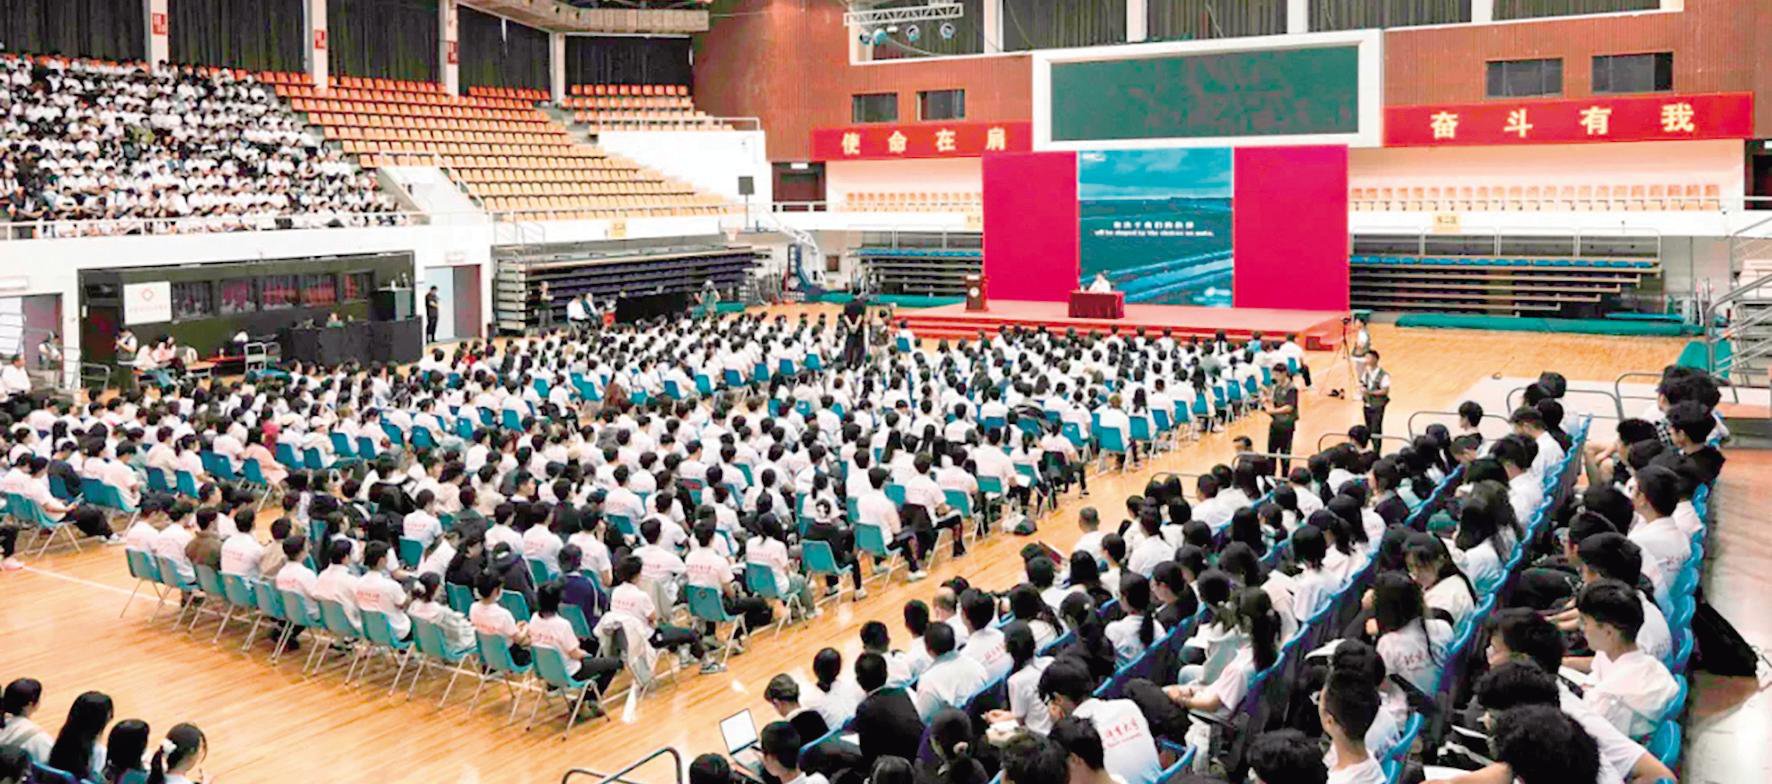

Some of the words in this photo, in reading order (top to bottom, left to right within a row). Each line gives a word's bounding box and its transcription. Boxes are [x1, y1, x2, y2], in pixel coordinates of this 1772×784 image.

[1430, 103, 1695, 139] 奋斗有我
[842, 127, 1006, 155] 使命在肩
